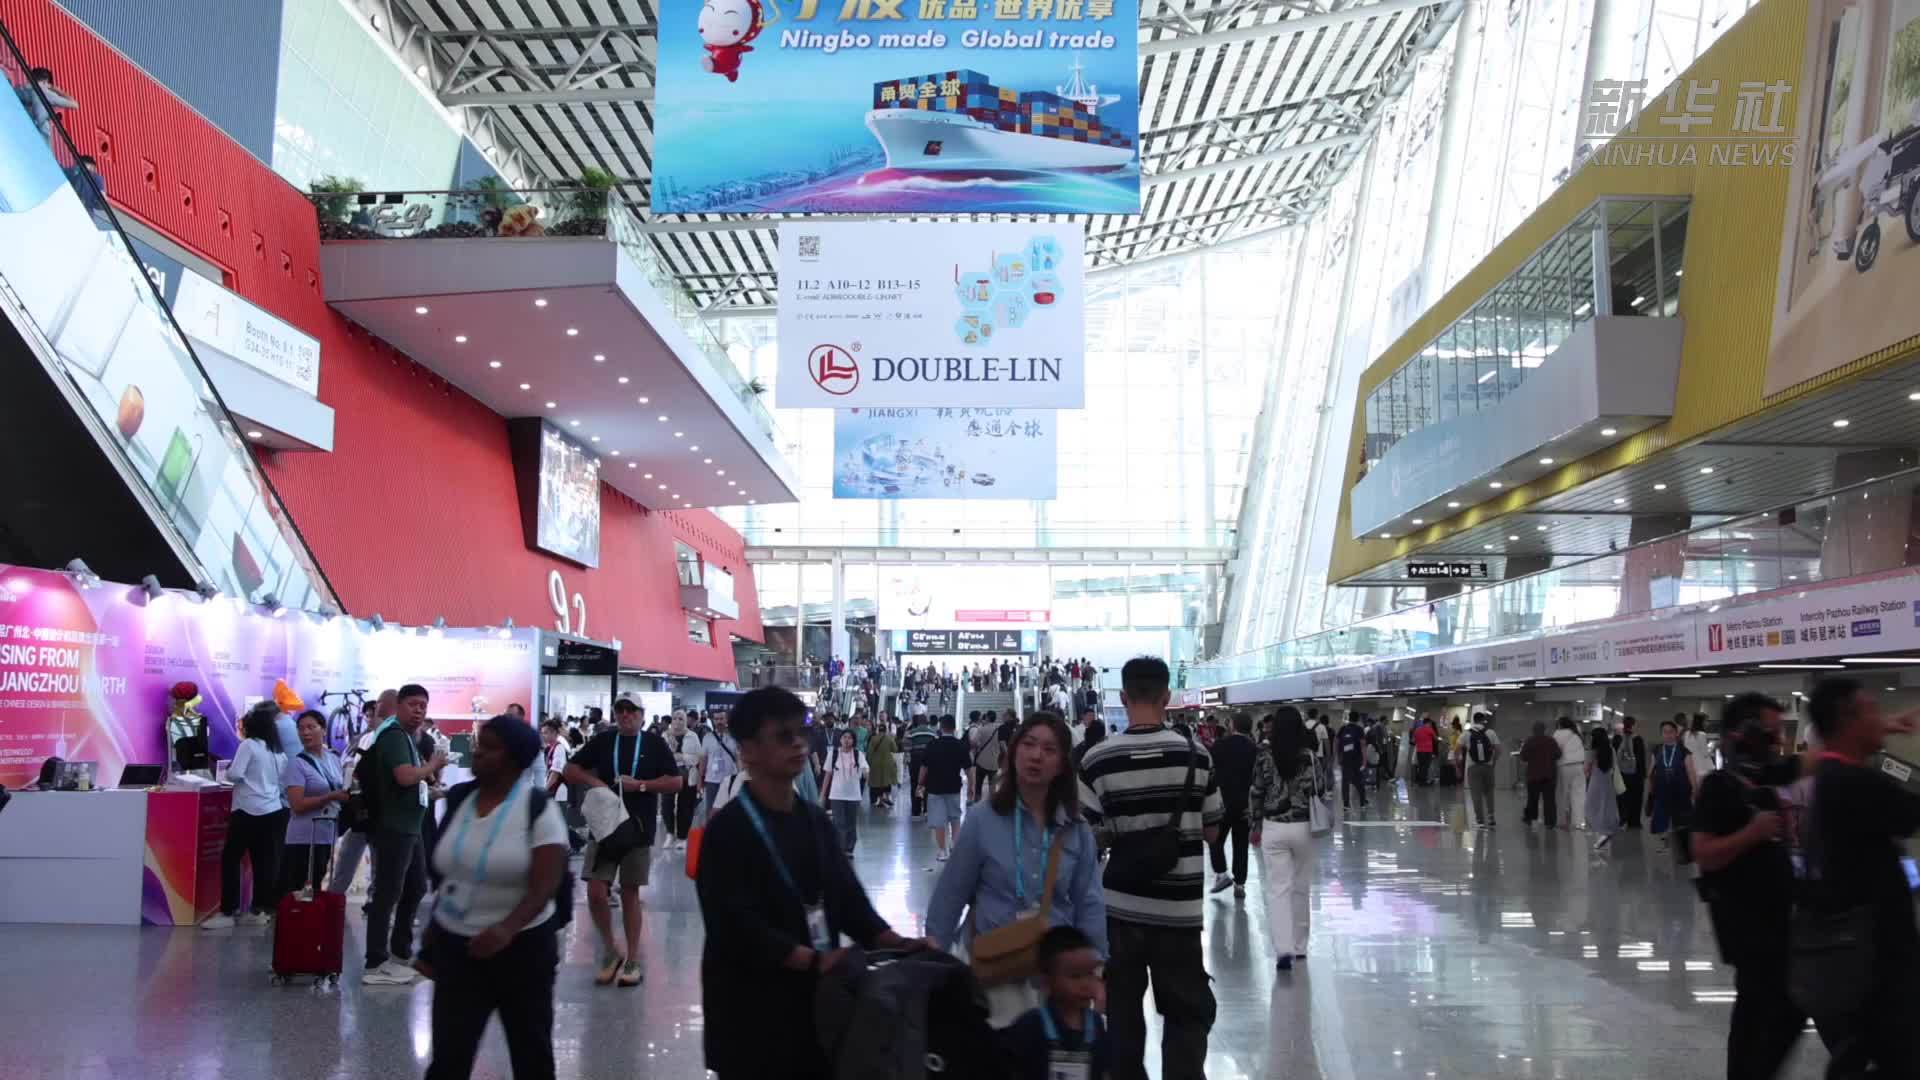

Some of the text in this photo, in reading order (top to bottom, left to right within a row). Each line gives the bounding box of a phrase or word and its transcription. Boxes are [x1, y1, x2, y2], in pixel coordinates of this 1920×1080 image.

[780, 29, 1116, 52] Ningbo made Global trade
[881, 79, 960, 102] 甬贸全球
[872, 357, 1063, 382] DOUBLE-LIN
[868, 407, 919, 419] JIANGXI
[1800, 612, 1825, 623] Intercity
[1852, 604, 1878, 617] Railway
[1880, 601, 1906, 613] Station
[0, 644, 79, 668] SING FROM
[81, 674, 126, 695] NRTH
